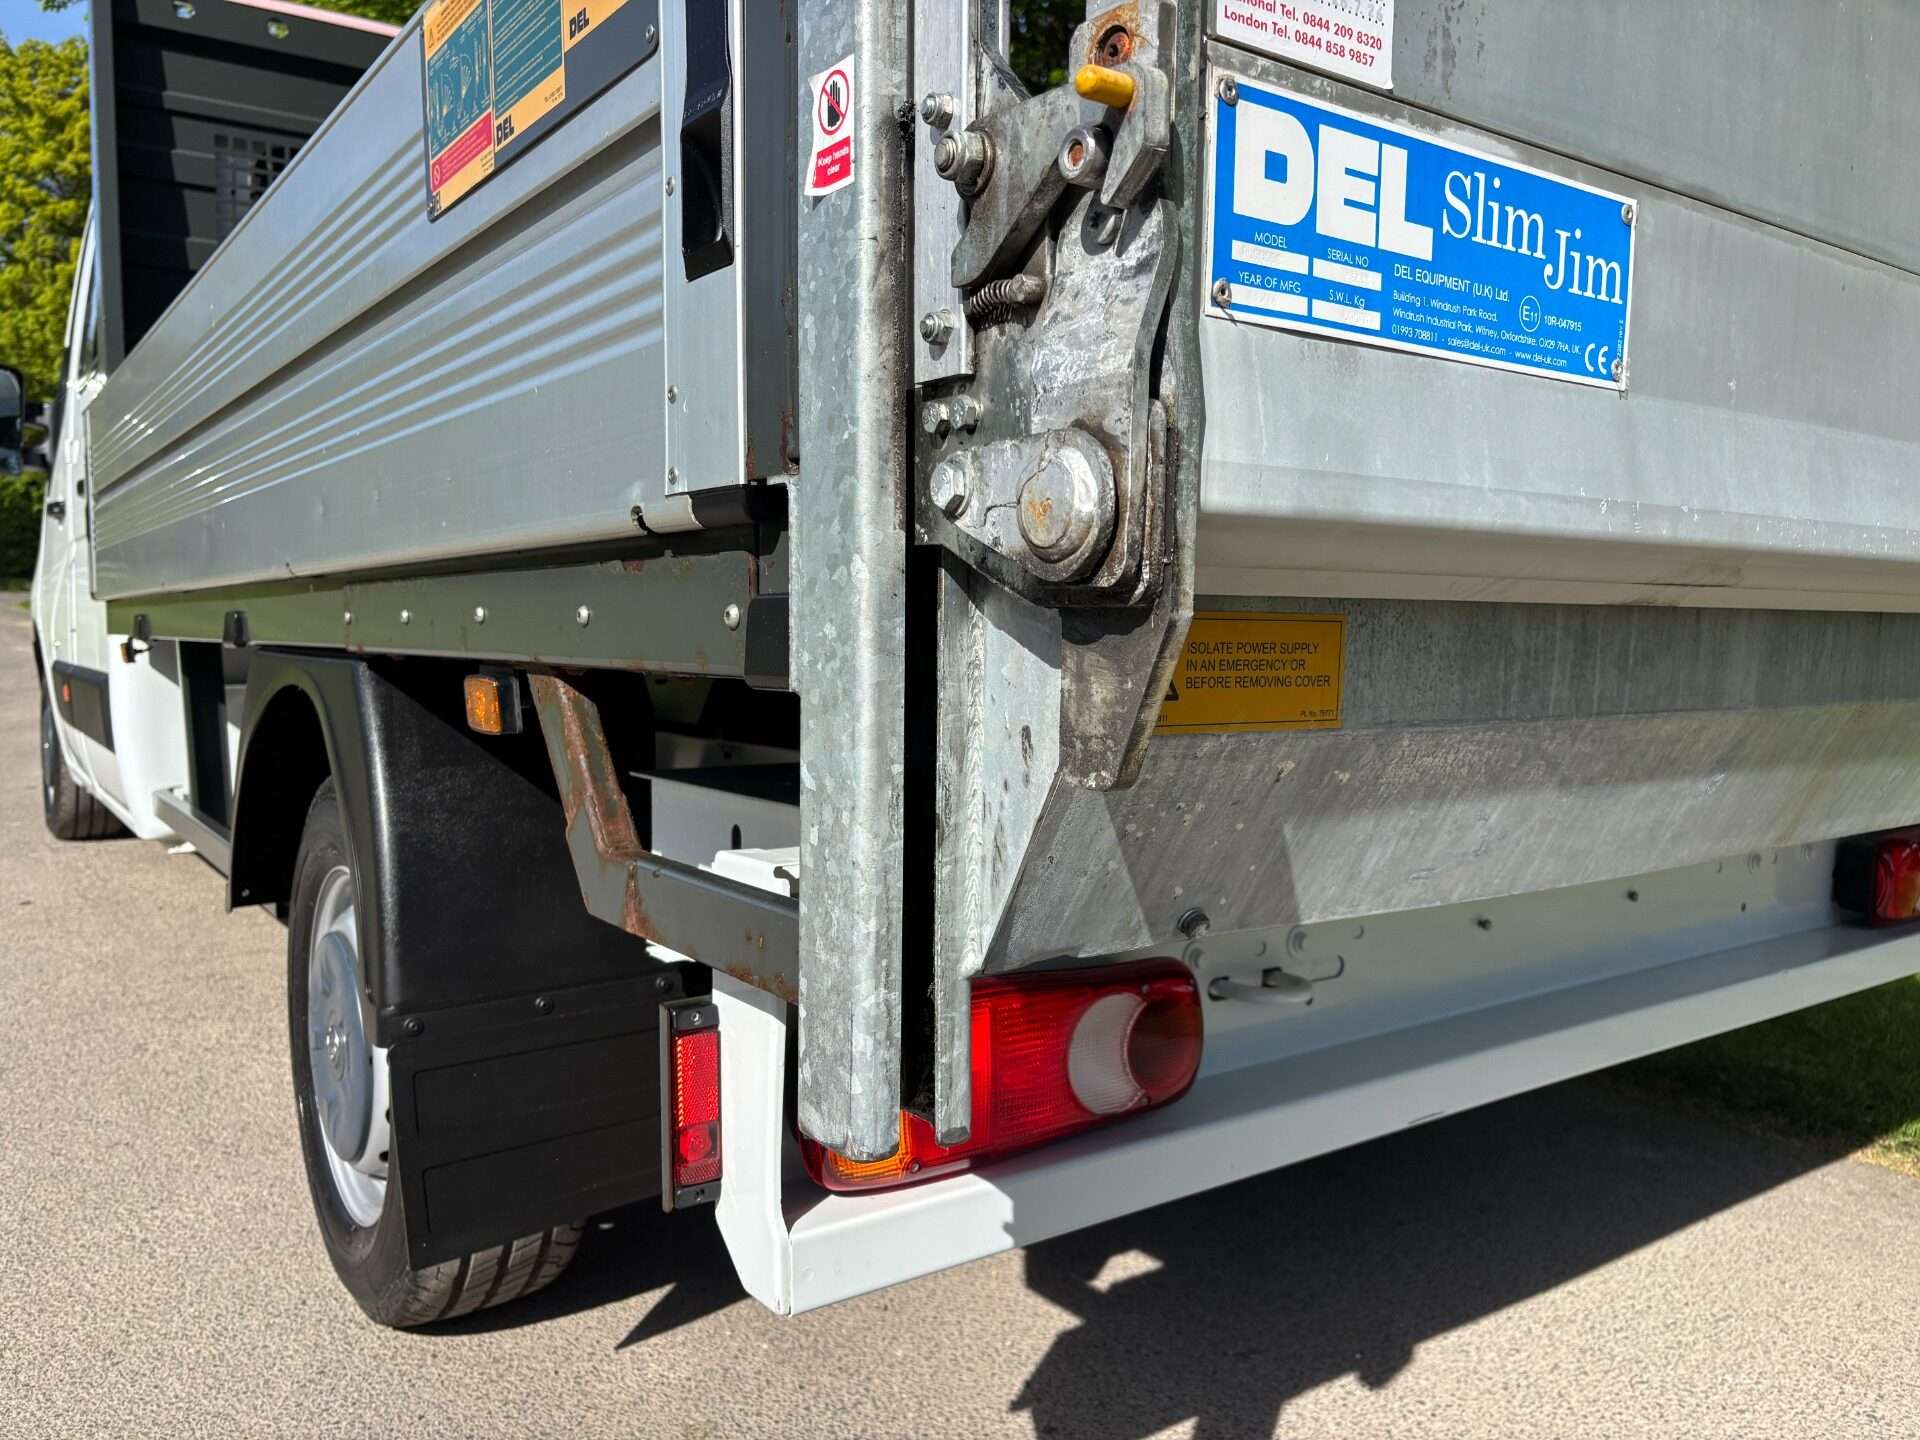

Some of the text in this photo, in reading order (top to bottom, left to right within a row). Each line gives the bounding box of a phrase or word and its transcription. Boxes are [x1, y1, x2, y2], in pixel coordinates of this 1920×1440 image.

[569, 7, 589, 40] DEL
[1280, 3, 1299, 21] Tel.
[1303, 11, 1330, 33] 0844
[1333, 23, 1353, 40] 209
[1356, 31, 1382, 50] 8320
[1224, 5, 1375, 67] London Tel. 0844 858 9857
[496, 114, 514, 146] DEL
[817, 145, 849, 168] Keep hands
[827, 163, 841, 176] clear
[1233, 98, 1434, 262] DEL
[1254, 231, 1287, 249] MODEL
[1442, 170, 1623, 305] Slim Jim
[1327, 247, 1369, 267] SERIAL NO
[1238, 270, 1302, 293] YEAR OF MFG
[1394, 263, 1413, 281] DEL
[1415, 268, 1471, 293] EQUIPMENT
[1329, 289, 1366, 310] S.W.L. Kg
[1392, 289, 1421, 308] Building
[1430, 297, 1461, 314] Windrush
[1462, 305, 1478, 317] Park
[1392, 307, 1425, 323] Windrush
[1426, 314, 1456, 330] Industrial
[1522, 305, 1538, 323] E11
[1544, 314, 1582, 332] 10R-047915
[1391, 323, 1413, 338] 01993
[1414, 327, 1438, 343] 708811
[1515, 350, 1567, 367] www.del-uk.com
[1584, 343, 1609, 375] CE
[1187, 640, 1320, 655] ISOLATE POWER SUPPLY
[1186, 658, 1306, 673] IN AN EMERGENCY OR
[1185, 674, 1332, 689] BEFORE REMOVING COVER
